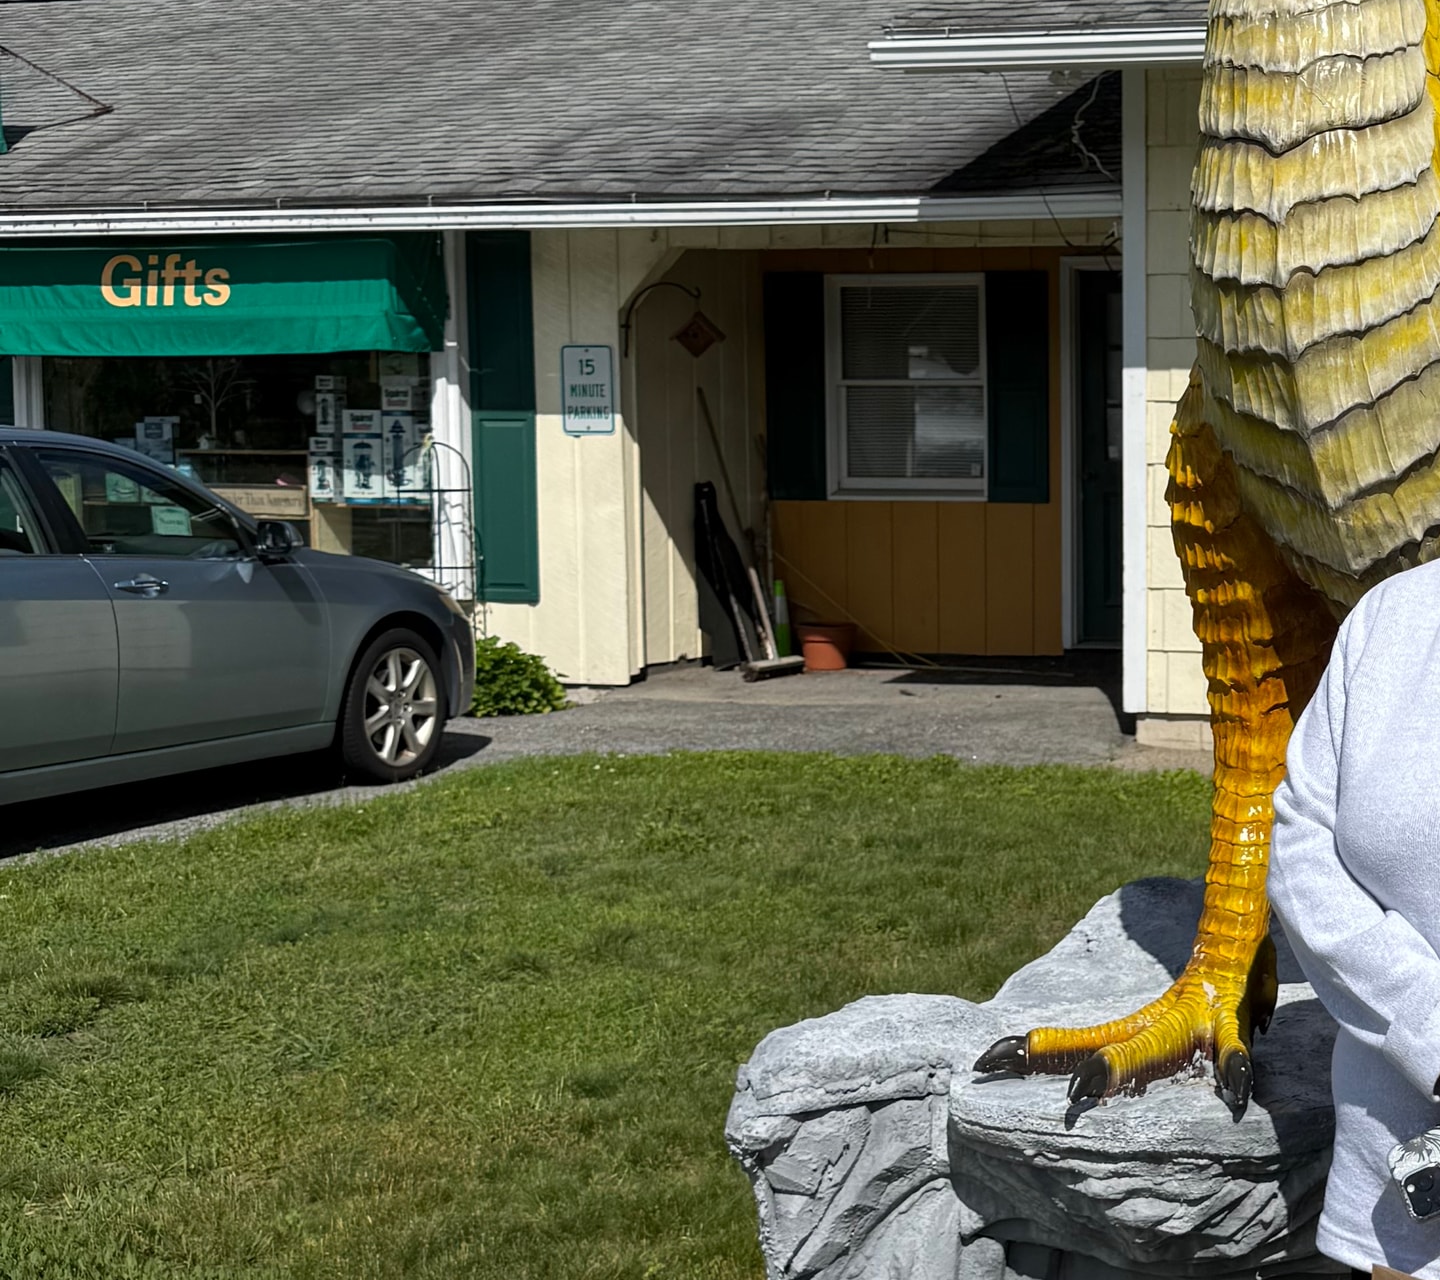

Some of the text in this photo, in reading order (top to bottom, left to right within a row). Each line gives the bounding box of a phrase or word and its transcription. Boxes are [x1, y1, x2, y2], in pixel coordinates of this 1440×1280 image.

[101, 253, 231, 307] Gifts
[578, 358, 596, 376] 15
[570, 383, 606, 398] MINUTE
[567, 405, 610, 420] PARKING
